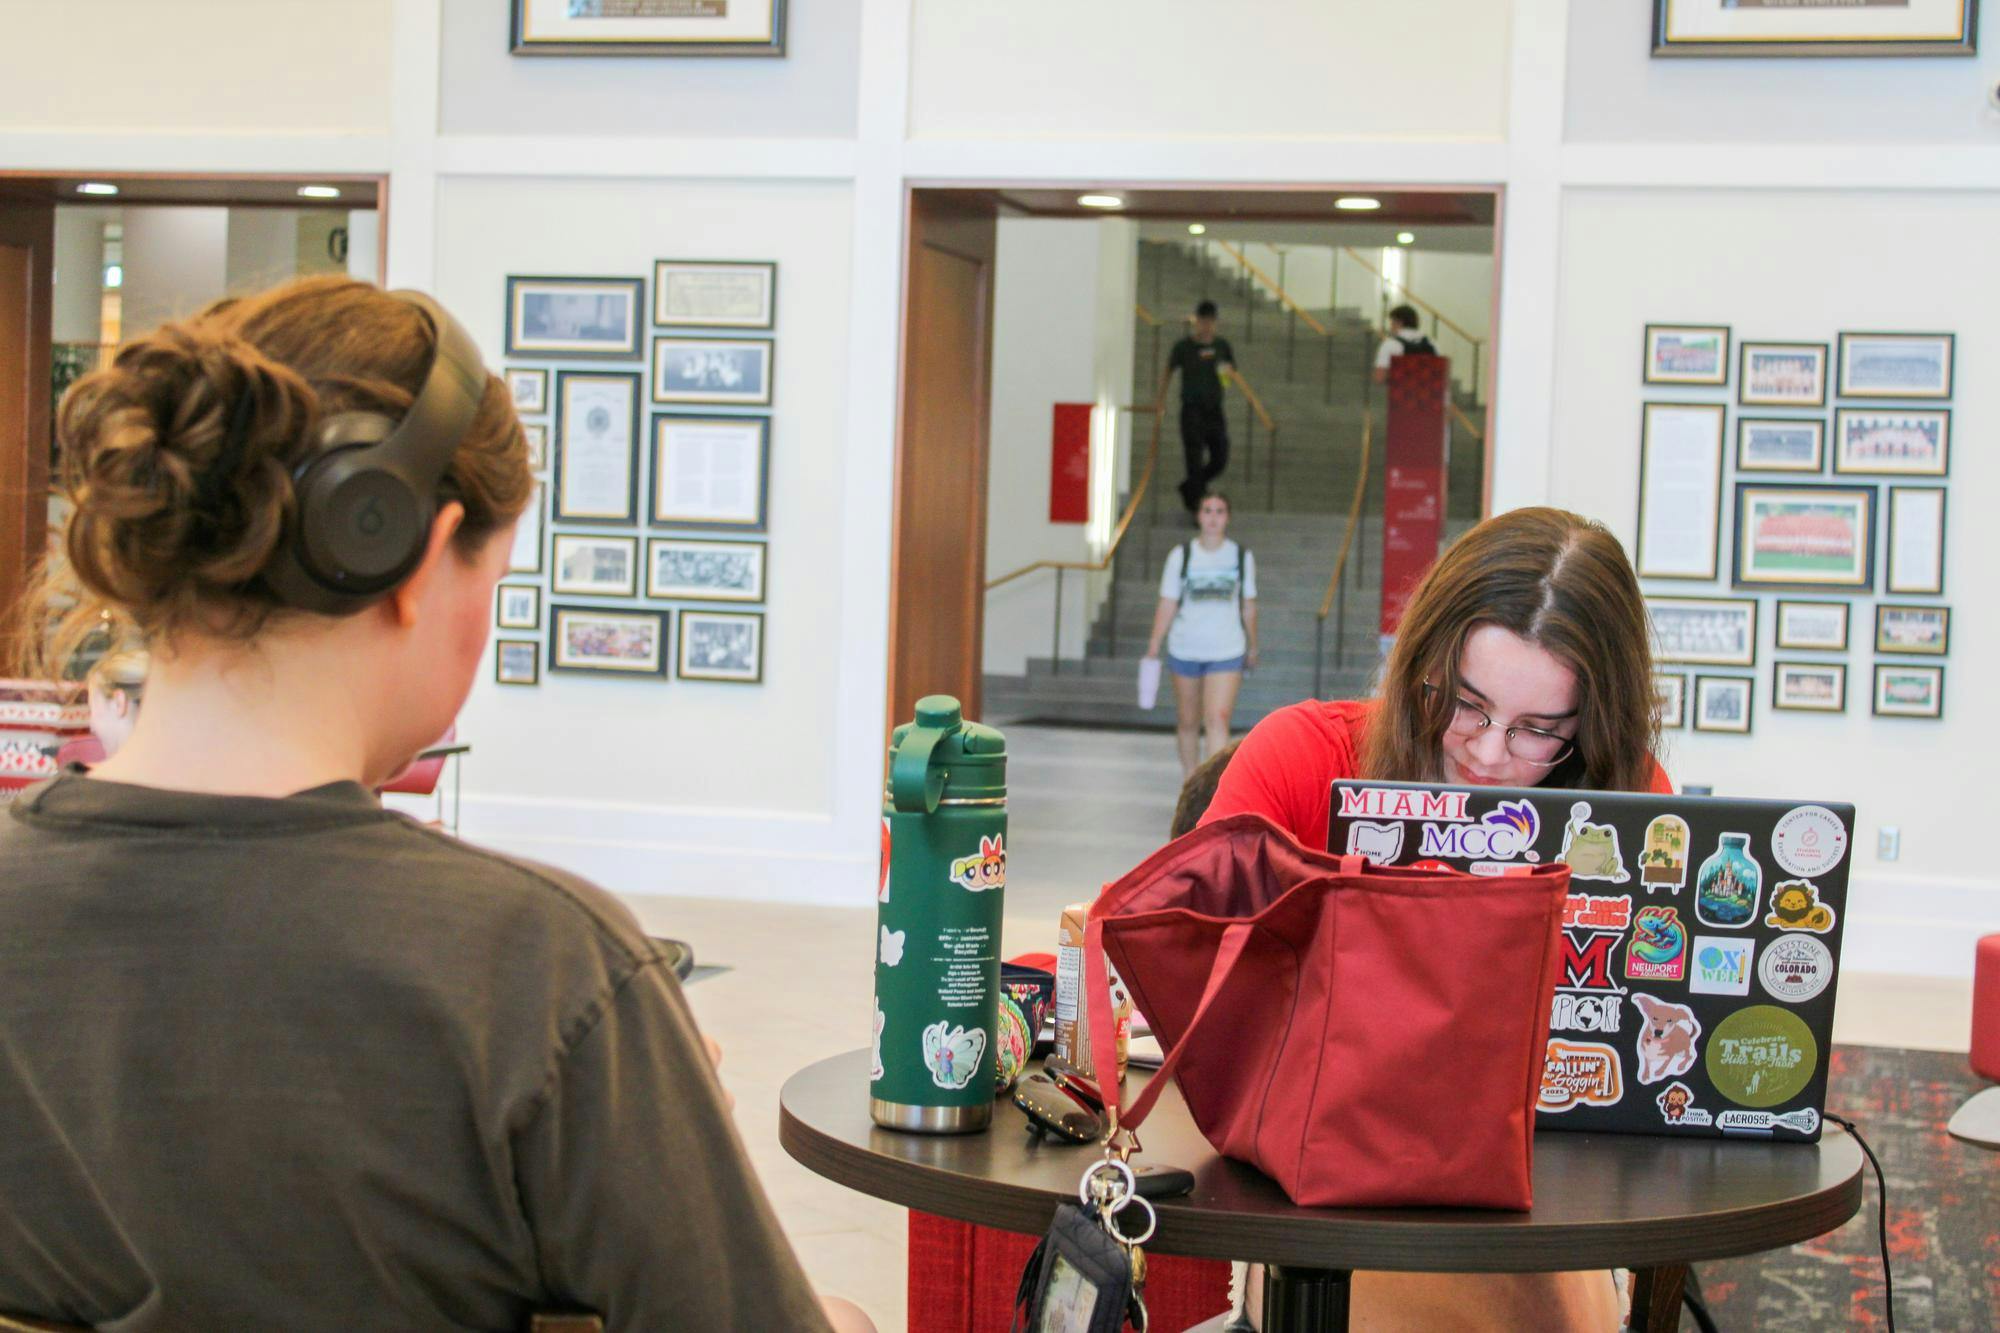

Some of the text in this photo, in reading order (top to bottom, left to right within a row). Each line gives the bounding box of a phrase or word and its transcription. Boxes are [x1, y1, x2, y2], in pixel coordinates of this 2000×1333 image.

[1341, 789, 1467, 819] MIAMI
[1782, 813, 1803, 828] CENTER
[1819, 814, 1839, 831] CAREER
[1425, 827, 1514, 856] MCC
[1360, 849, 1382, 857] HOME
[1773, 940, 1821, 956] KEYSTONE
[1631, 962, 1679, 974] NEWPORT
[1774, 964, 1817, 974] COLORADO
[1740, 1035, 1787, 1045] Celebrate
[1719, 1038, 1802, 1063] Trails
[1724, 1113, 1770, 1126] LACROSSE
